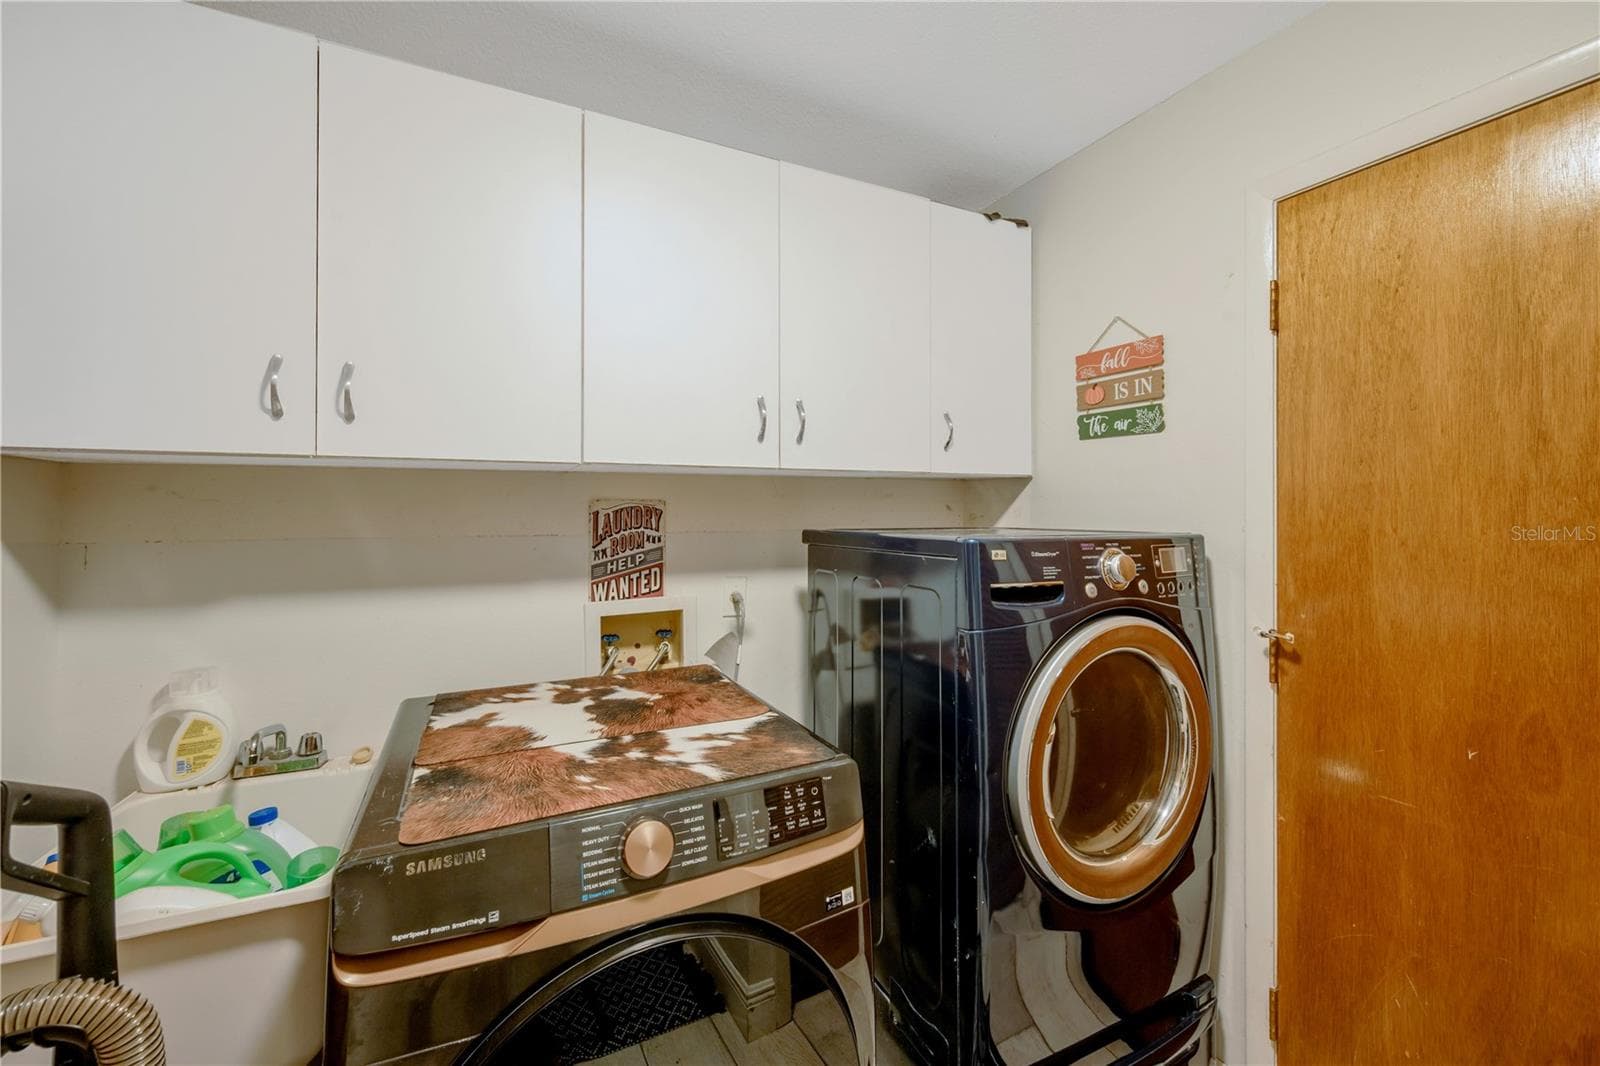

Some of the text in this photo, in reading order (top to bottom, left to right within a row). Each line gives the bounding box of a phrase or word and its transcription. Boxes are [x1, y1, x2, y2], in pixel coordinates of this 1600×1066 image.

[1100, 346, 1130, 373] fall
[1114, 376, 1153, 400] IS IN
[1114, 418, 1132, 431] air
[592, 505, 663, 549] LAUNDRY
[610, 531, 645, 557] ROOM
[607, 553, 645, 574] HELP
[592, 567, 661, 602] WANTED
[683, 815, 705, 824] DELICATES
[581, 825, 601, 833] NORMAL
[690, 825, 705, 833] TOWELS
[597, 835, 610, 843] DUTY
[582, 848, 603, 857] BEDDING
[684, 848, 693, 856] SELF
[405, 848, 486, 876] SAMSUNG
[583, 856, 617, 869] STEAM NORMAL
[583, 871, 598, 880] STEAM
[583, 878, 617, 891] STEAM SANITIZE
[391, 917, 487, 942] SuperSpeed Steam SmartThings
